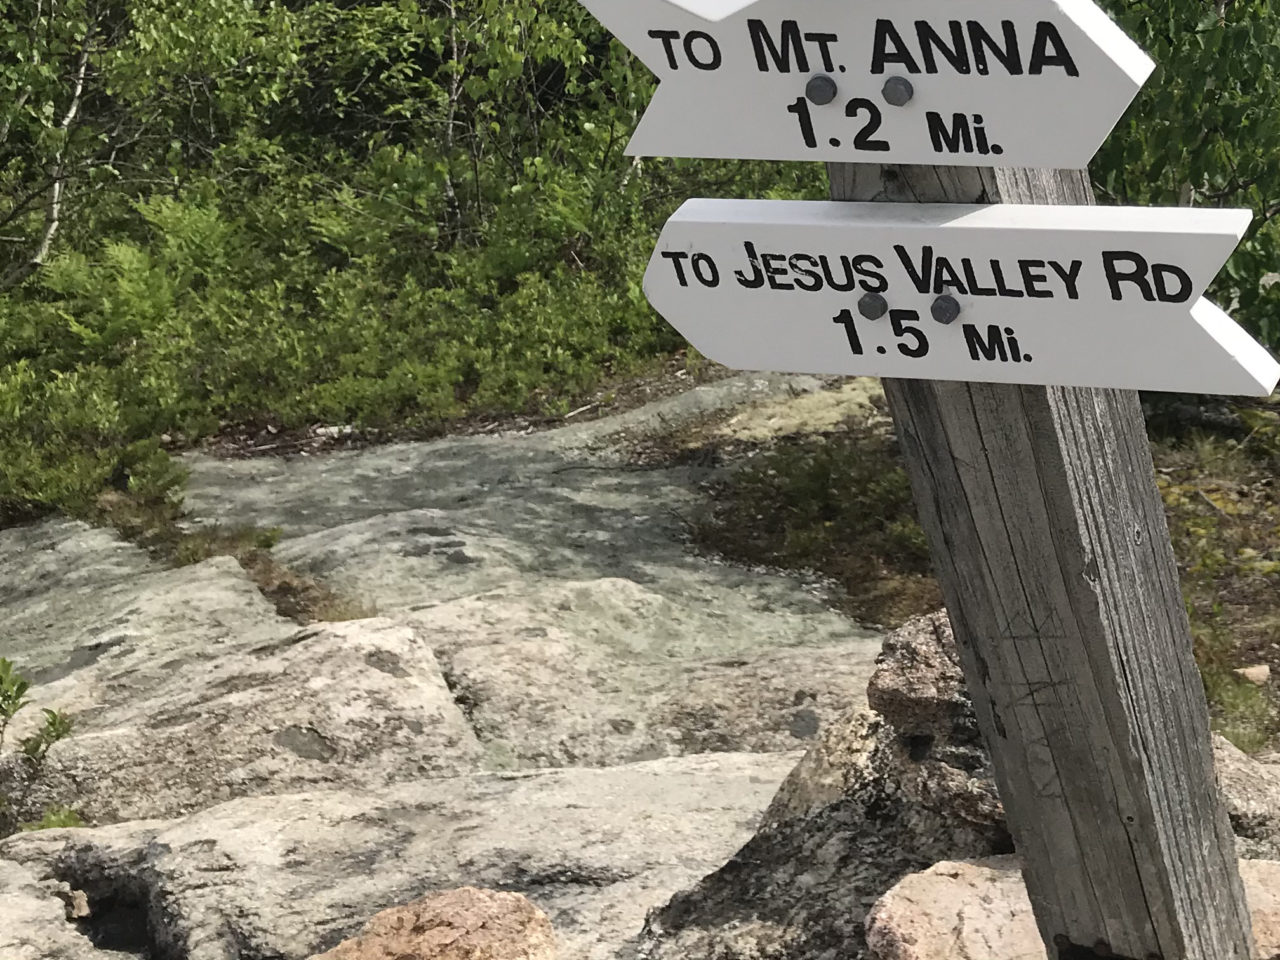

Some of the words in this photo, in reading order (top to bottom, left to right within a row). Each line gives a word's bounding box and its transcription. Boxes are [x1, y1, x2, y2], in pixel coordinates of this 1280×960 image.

[647, 29, 722, 72] TO
[747, 19, 847, 73] MT.
[870, 18, 1080, 78] ANNA
[787, 96, 891, 152] 1.2
[925, 111, 1004, 155] Mi.
[661, 249, 720, 288] TO
[733, 241, 888, 294] JESUS
[893, 244, 1083, 300] VALLEY
[1102, 250, 1193, 304] RD
[833, 308, 928, 358] 1.5
[961, 323, 1033, 363] Mi.
